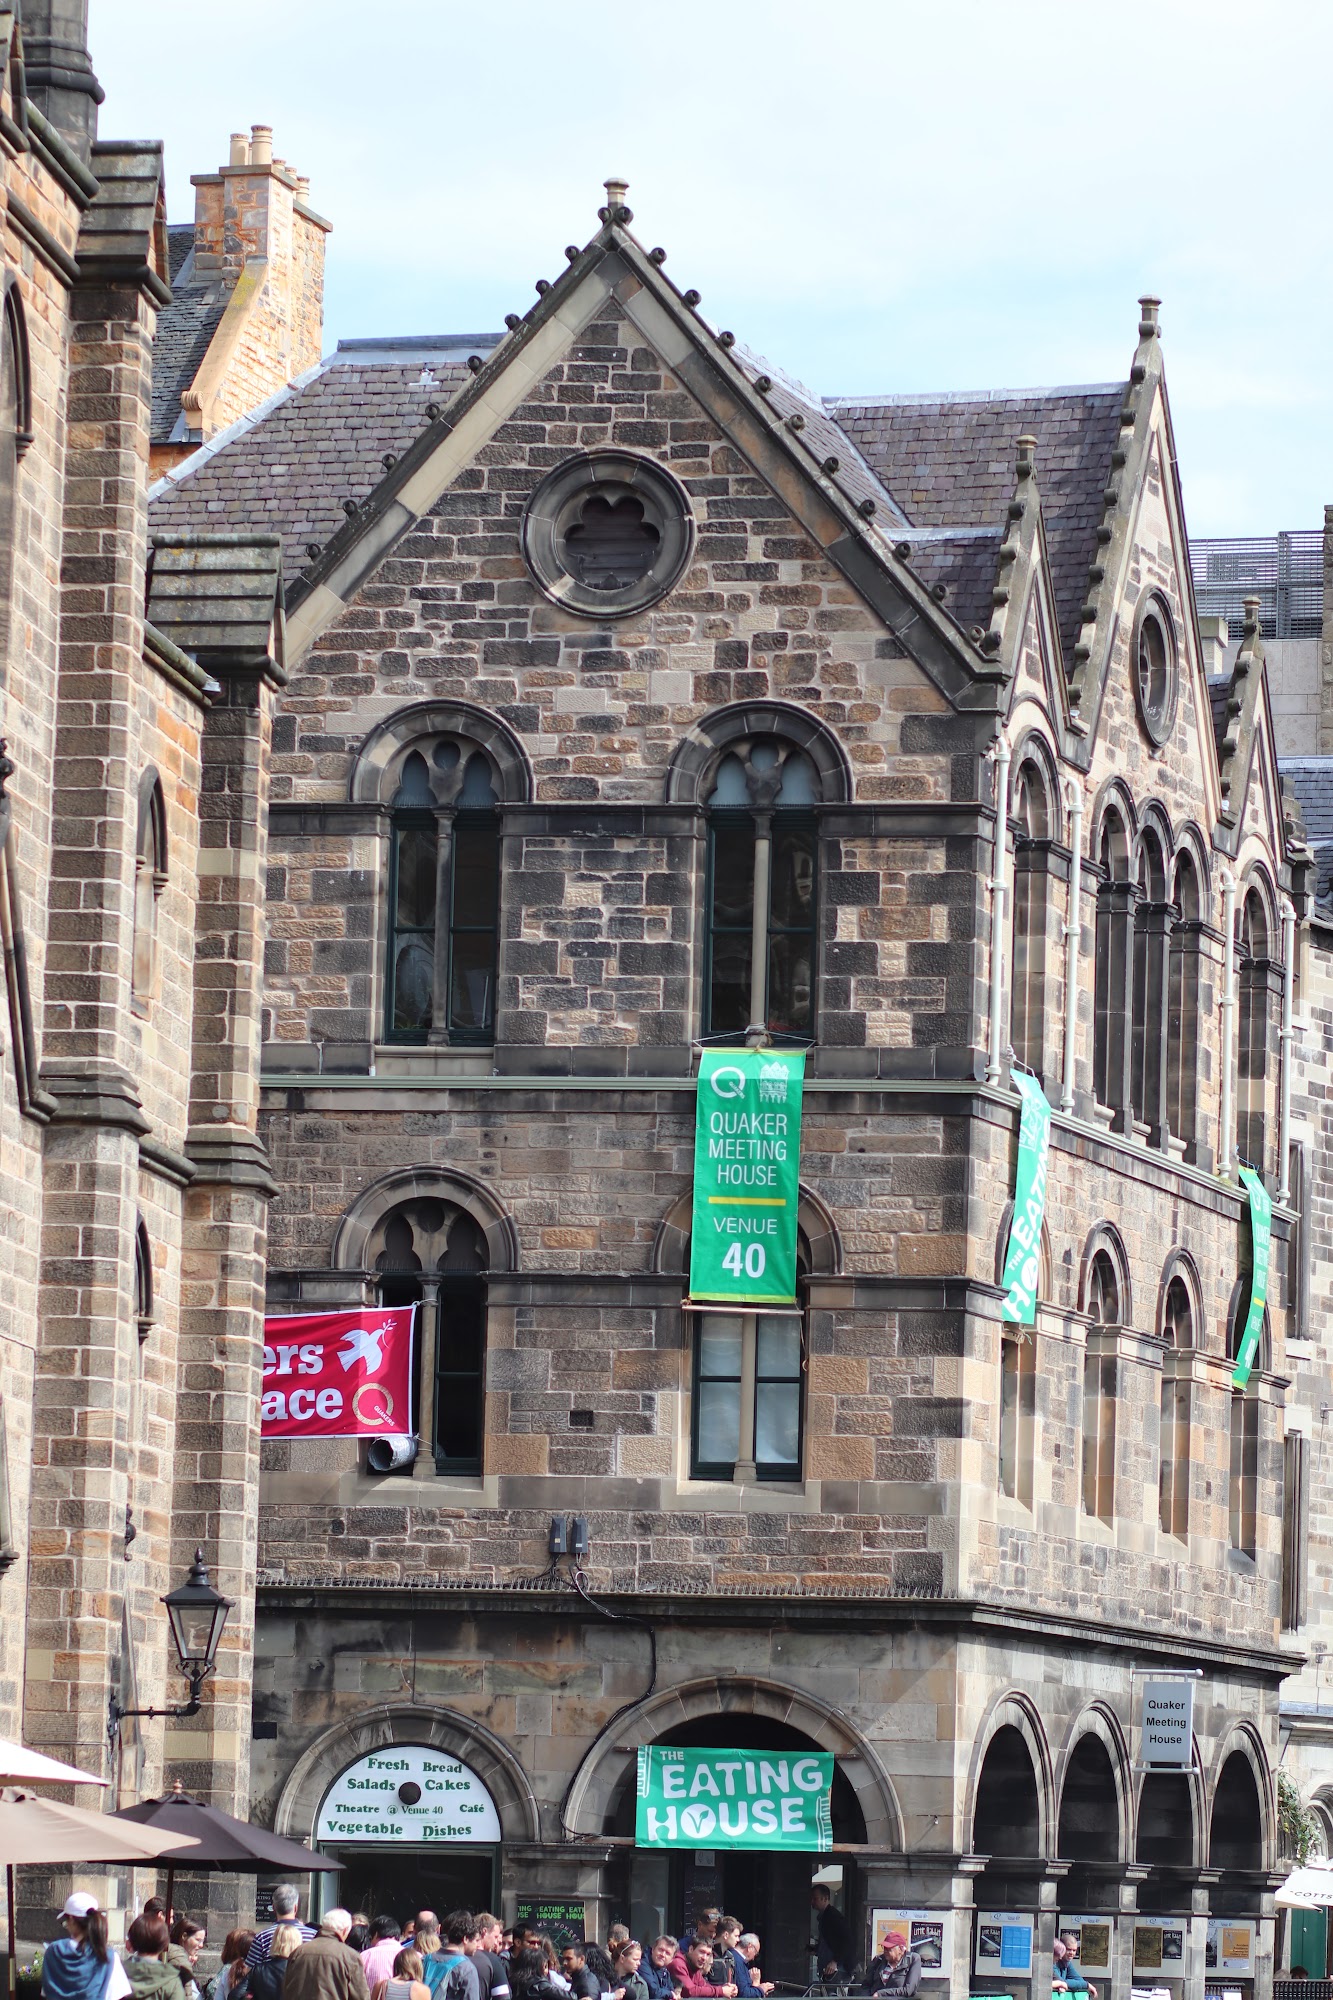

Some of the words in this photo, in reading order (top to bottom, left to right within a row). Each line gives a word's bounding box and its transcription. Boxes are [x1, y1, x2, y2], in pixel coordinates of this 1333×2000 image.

[710, 1111, 788, 1136] QUAKER
[717, 1163, 777, 1186] HOUSE
[713, 1216, 778, 1235] VENUE
[722, 1242, 766, 1278] 40
[1008, 1248, 1025, 1272] THE
[373, 1405, 395, 1427] QUAKERS
[1148, 1699, 1186, 1710] Quaker
[1146, 1717, 1187, 1729] Meeting
[1149, 1734, 1182, 1744] House
[659, 1751, 684, 1761] THE
[367, 1757, 410, 1771] Fresh
[422, 1761, 463, 1774] Bread
[347, 1778, 396, 1791] Salads
[424, 1779, 471, 1791] Cakes
[662, 1758, 823, 1799] EATING
[335, 1803, 380, 1813] Theatre
[386, 1804, 398, 1816] @
[401, 1805, 430, 1815] Venue
[432, 1805, 443, 1815] 40
[459, 1803, 485, 1813] Café
[646, 1797, 806, 1841] HOUSE
[326, 1820, 403, 1835] Vegetable
[422, 1824, 472, 1837] Dishes
[1290, 1890, 1333, 1900] COTTS
[539, 1905, 566, 1913] EATING
